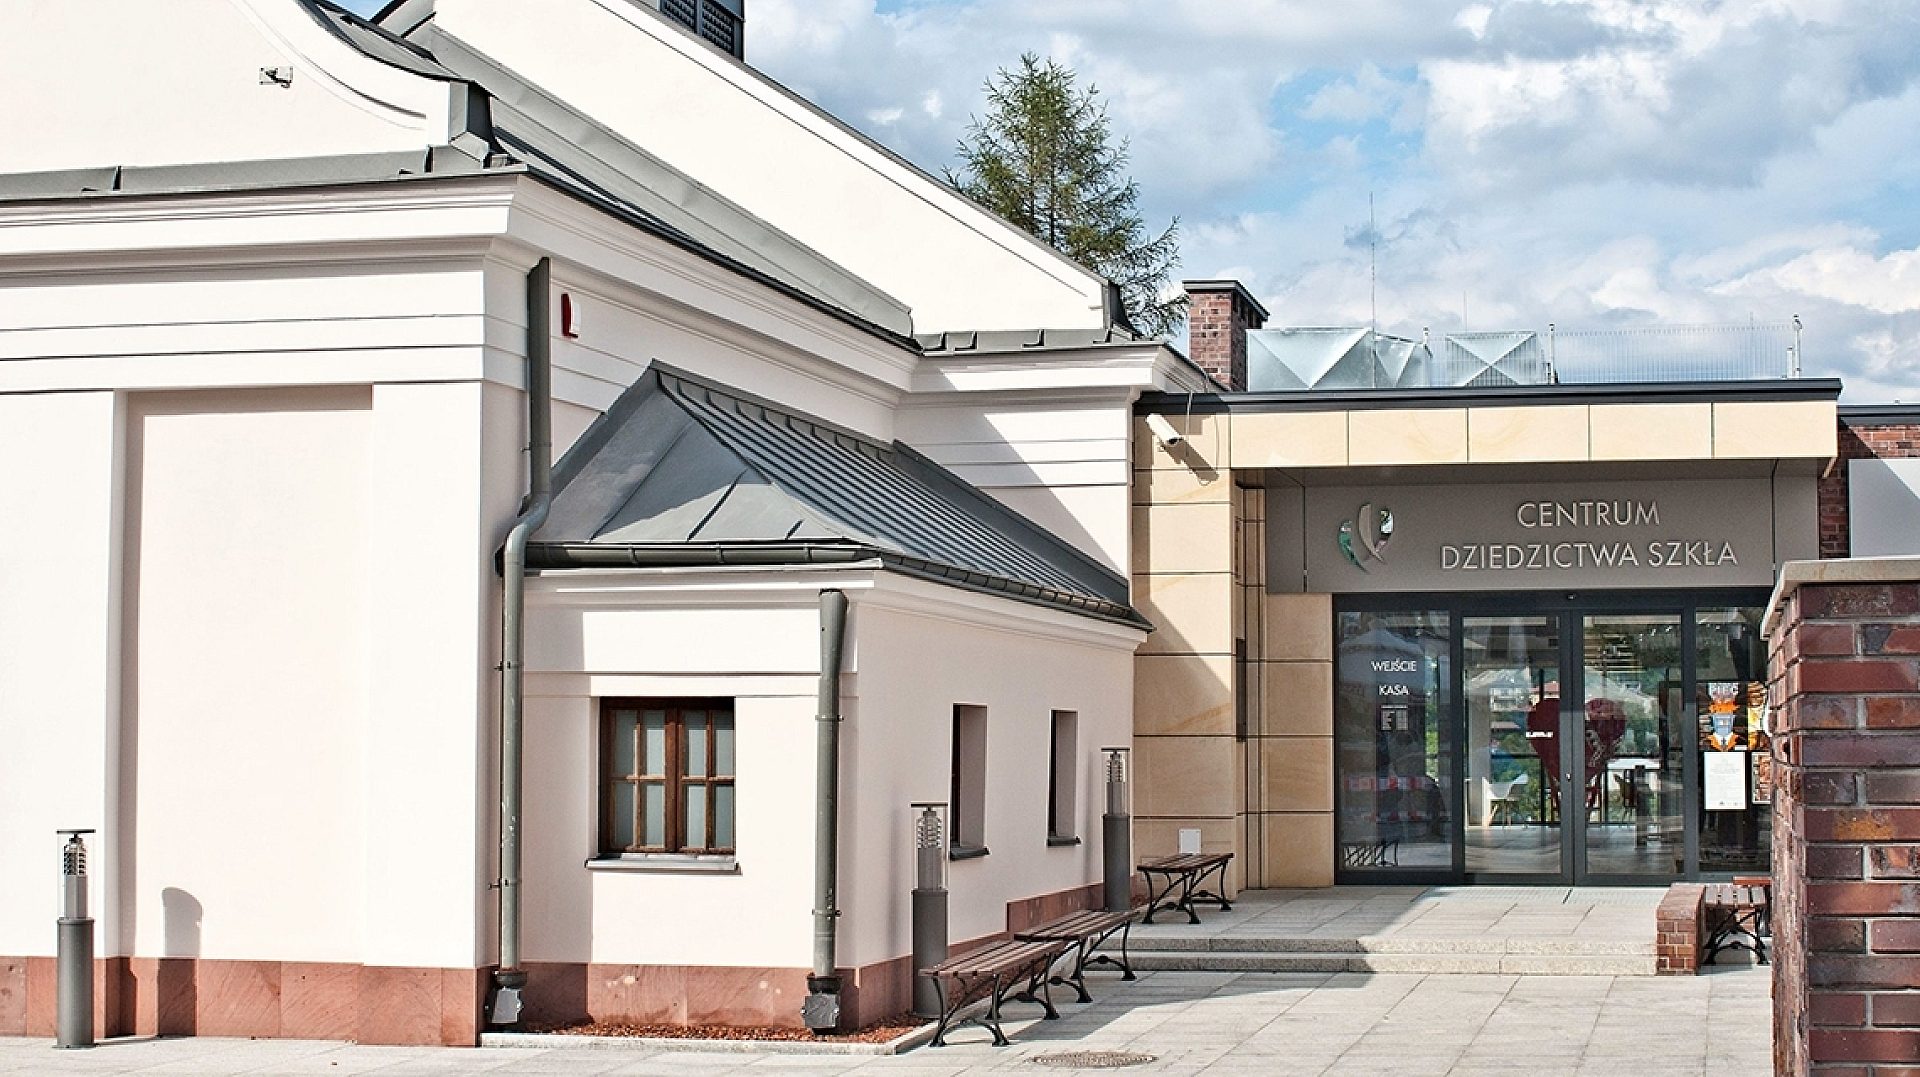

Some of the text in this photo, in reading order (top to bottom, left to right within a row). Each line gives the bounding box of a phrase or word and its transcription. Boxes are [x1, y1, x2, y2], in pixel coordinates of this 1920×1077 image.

[1517, 501, 1660, 527] CENTRUM
[1441, 541, 1738, 569] DZIEDZICTWA SZKŁA
[1370, 658, 1417, 672] WEJŚCIE
[1378, 684, 1409, 696] KASA
